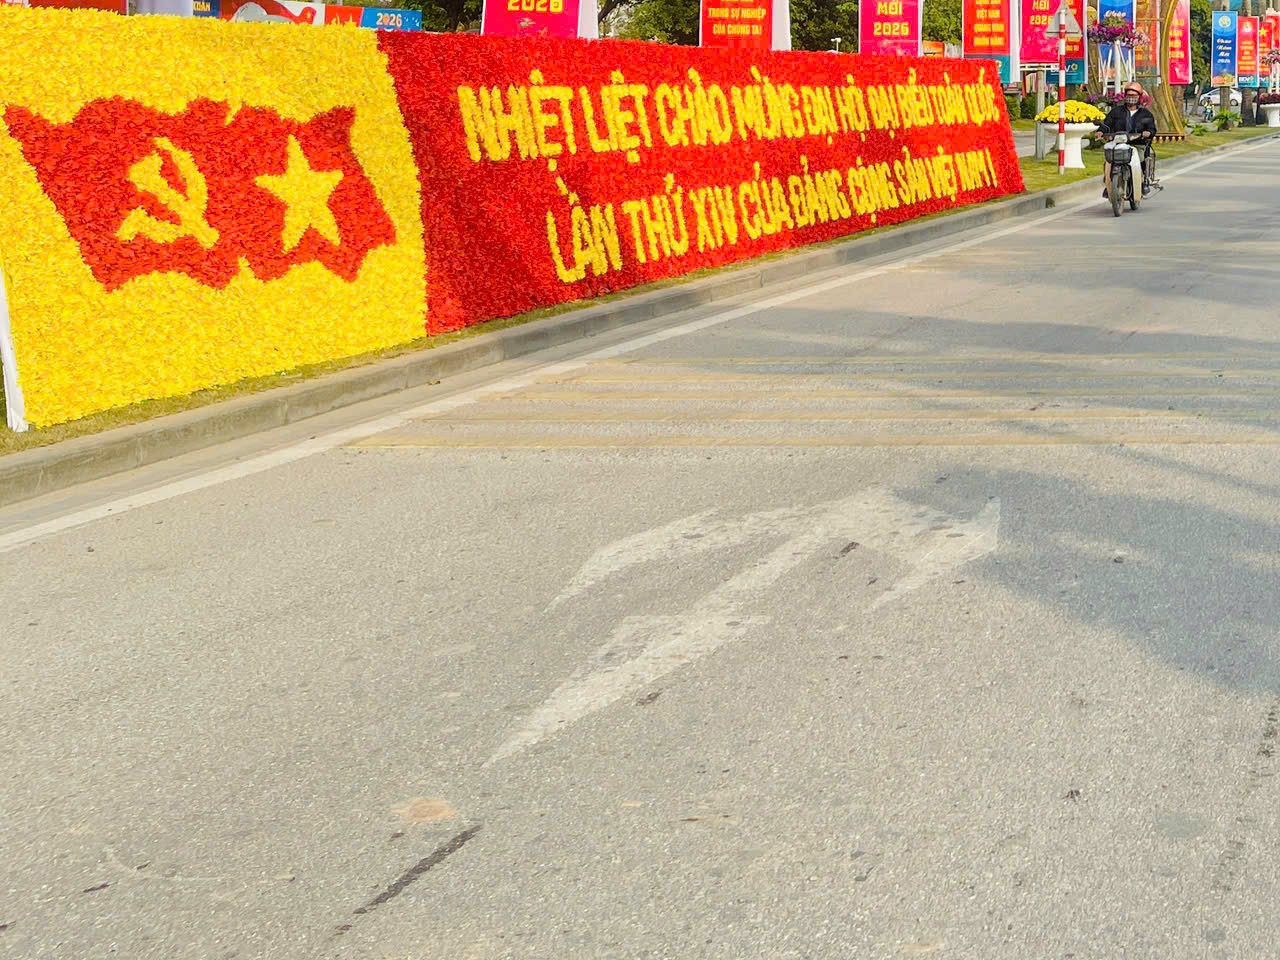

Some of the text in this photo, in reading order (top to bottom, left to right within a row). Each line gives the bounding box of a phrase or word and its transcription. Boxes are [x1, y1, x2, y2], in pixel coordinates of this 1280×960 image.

[877, 0, 903, 15] MỚI
[376, 12, 402, 27] 2026
[873, 22, 909, 36] 2026
[457, 69, 576, 171] NHIỆT
[579, 69, 652, 163] LIỆT
[655, 68, 733, 146] CHÀO
[731, 65, 805, 141] MỪNG
[836, 74, 870, 142] HỘI
[546, 176, 623, 283] LẦN
[622, 173, 689, 264] THỨ
[689, 185, 738, 253] XIV
[739, 161, 794, 240] CỦA
[788, 155, 851, 228] ĐẢNG
[848, 155, 900, 223] CỘNG
[894, 145, 932, 206] SẢN
[927, 145, 958, 202] VIỆT
